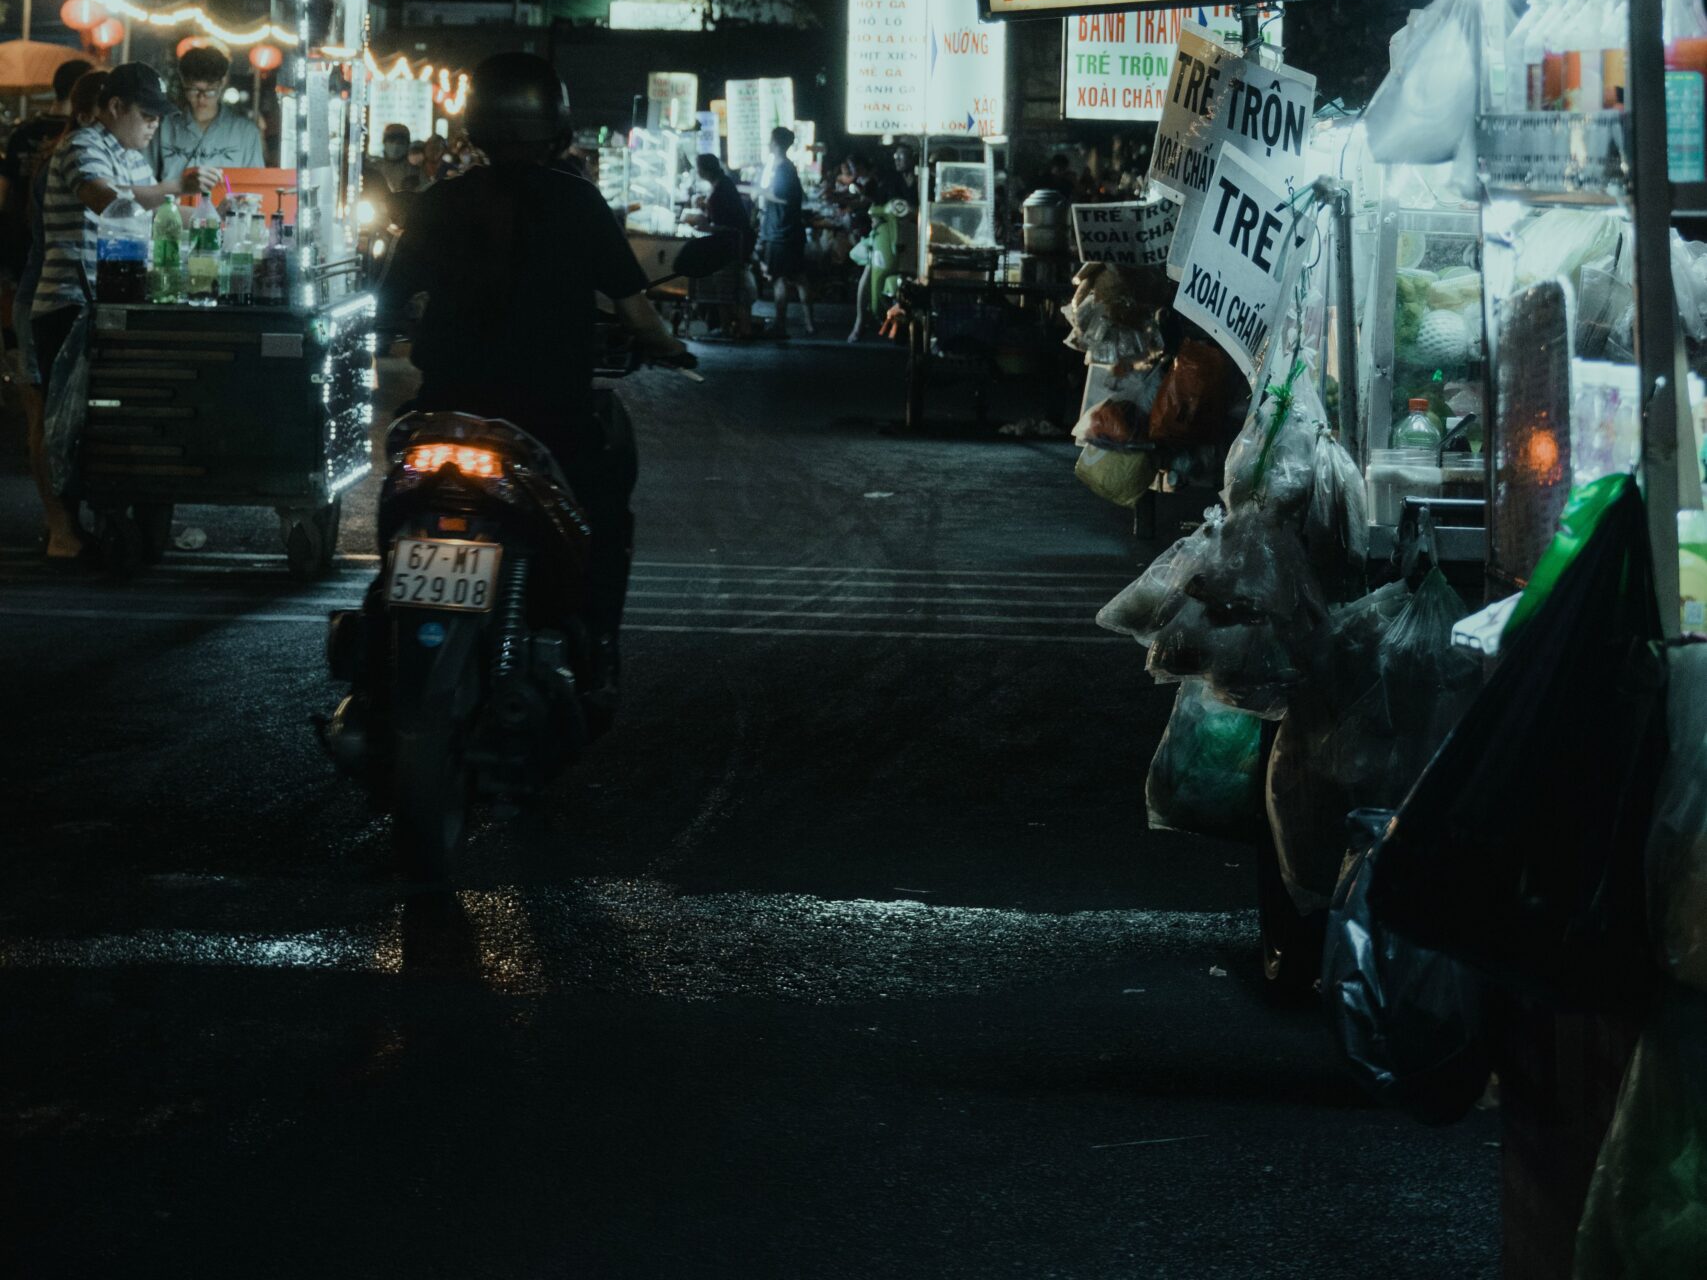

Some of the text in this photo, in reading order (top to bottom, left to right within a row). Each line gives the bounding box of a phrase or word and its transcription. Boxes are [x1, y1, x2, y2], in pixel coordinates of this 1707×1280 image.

[1076, 51, 1168, 80] TRÉ TRỘN
[1077, 82, 1116, 108] XOÀI
[1173, 51, 1306, 157] TRÉ TRỘN
[1078, 206, 1122, 222] TRÉ
[1135, 214, 1180, 243] CHẤ
[1212, 175, 1287, 274] TRÉ
[1184, 263, 1228, 318] XOÀI
[408, 544, 479, 574] 67-M1
[391, 573, 487, 605] 529.08
